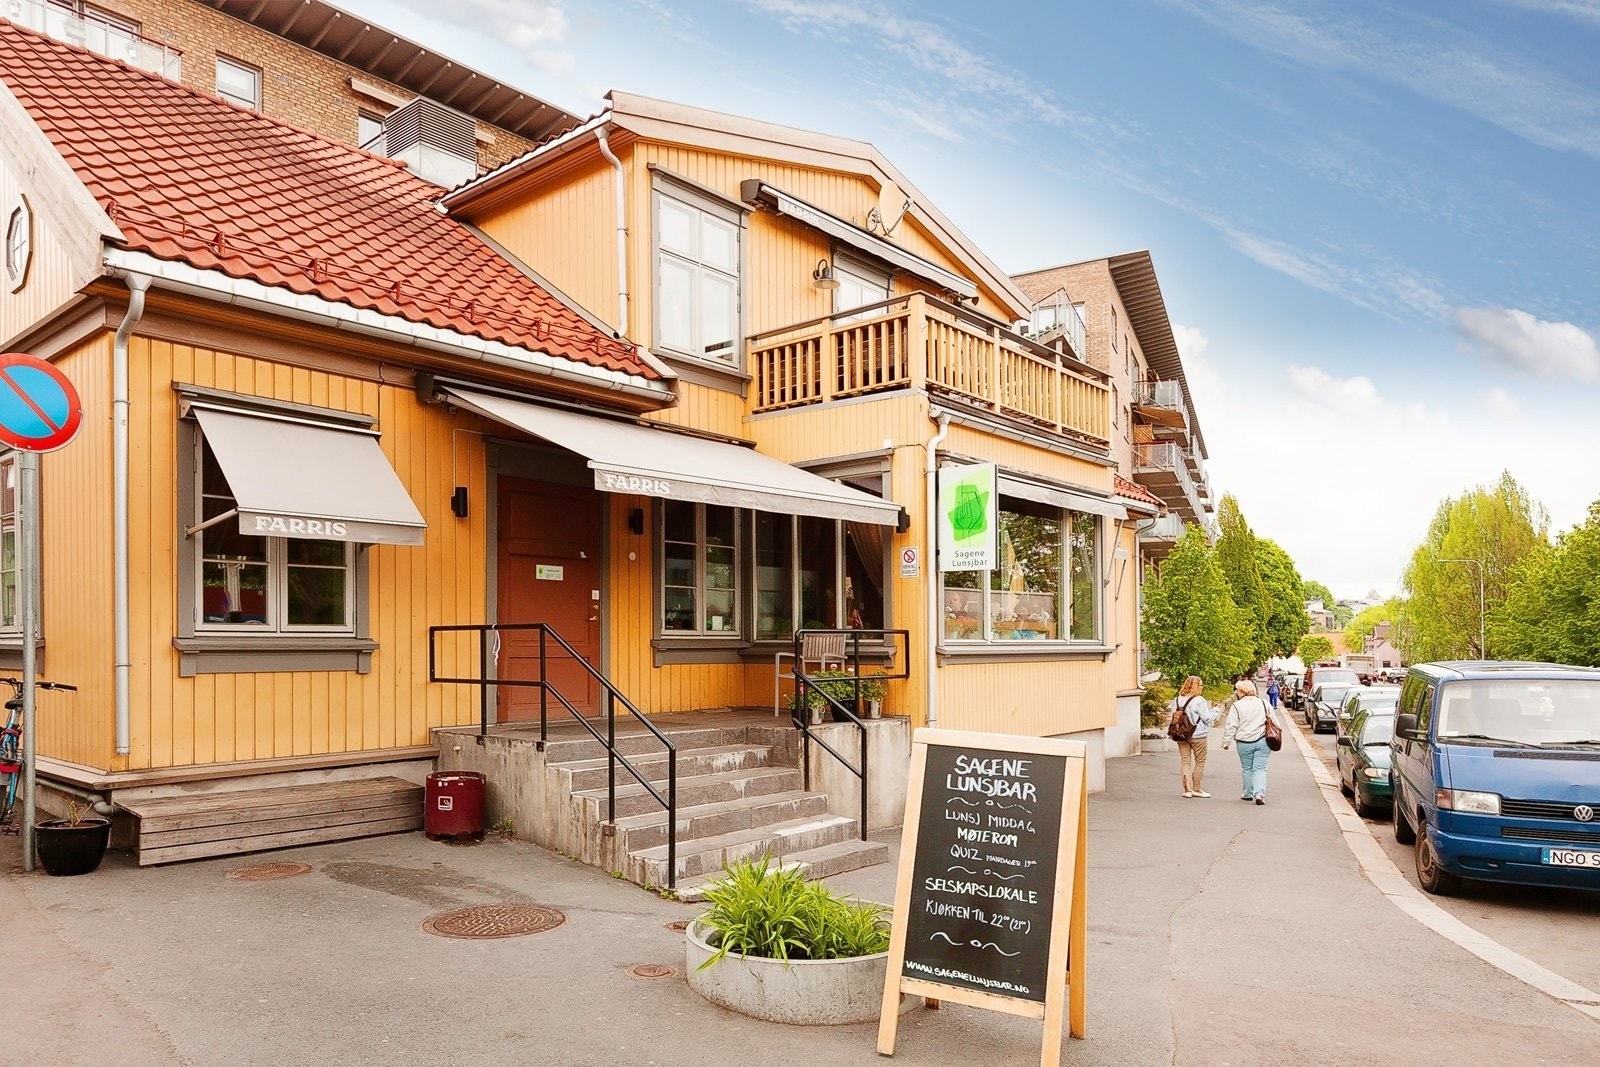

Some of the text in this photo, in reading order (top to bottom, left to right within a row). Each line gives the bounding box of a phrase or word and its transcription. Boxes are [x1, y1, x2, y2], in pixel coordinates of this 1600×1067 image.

[605, 473, 671, 495] FARRIS
[255, 515, 348, 537] FARRIS
[952, 559, 988, 568] Lunsjbar
[954, 550, 985, 560] Sagene
[953, 754, 1033, 778] SAGENE
[946, 774, 1037, 803] LUNSJBAR
[945, 808, 1036, 834] LUNSJ MIDDAG
[957, 826, 1018, 847] MØTEROM
[950, 844, 983, 861] QUIZ
[1552, 851, 1586, 865] NGO
[925, 877, 1038, 904] SELSKAPSLOKALE
[925, 899, 970, 920] KJØKKEN
[971, 908, 988, 924] TIL
